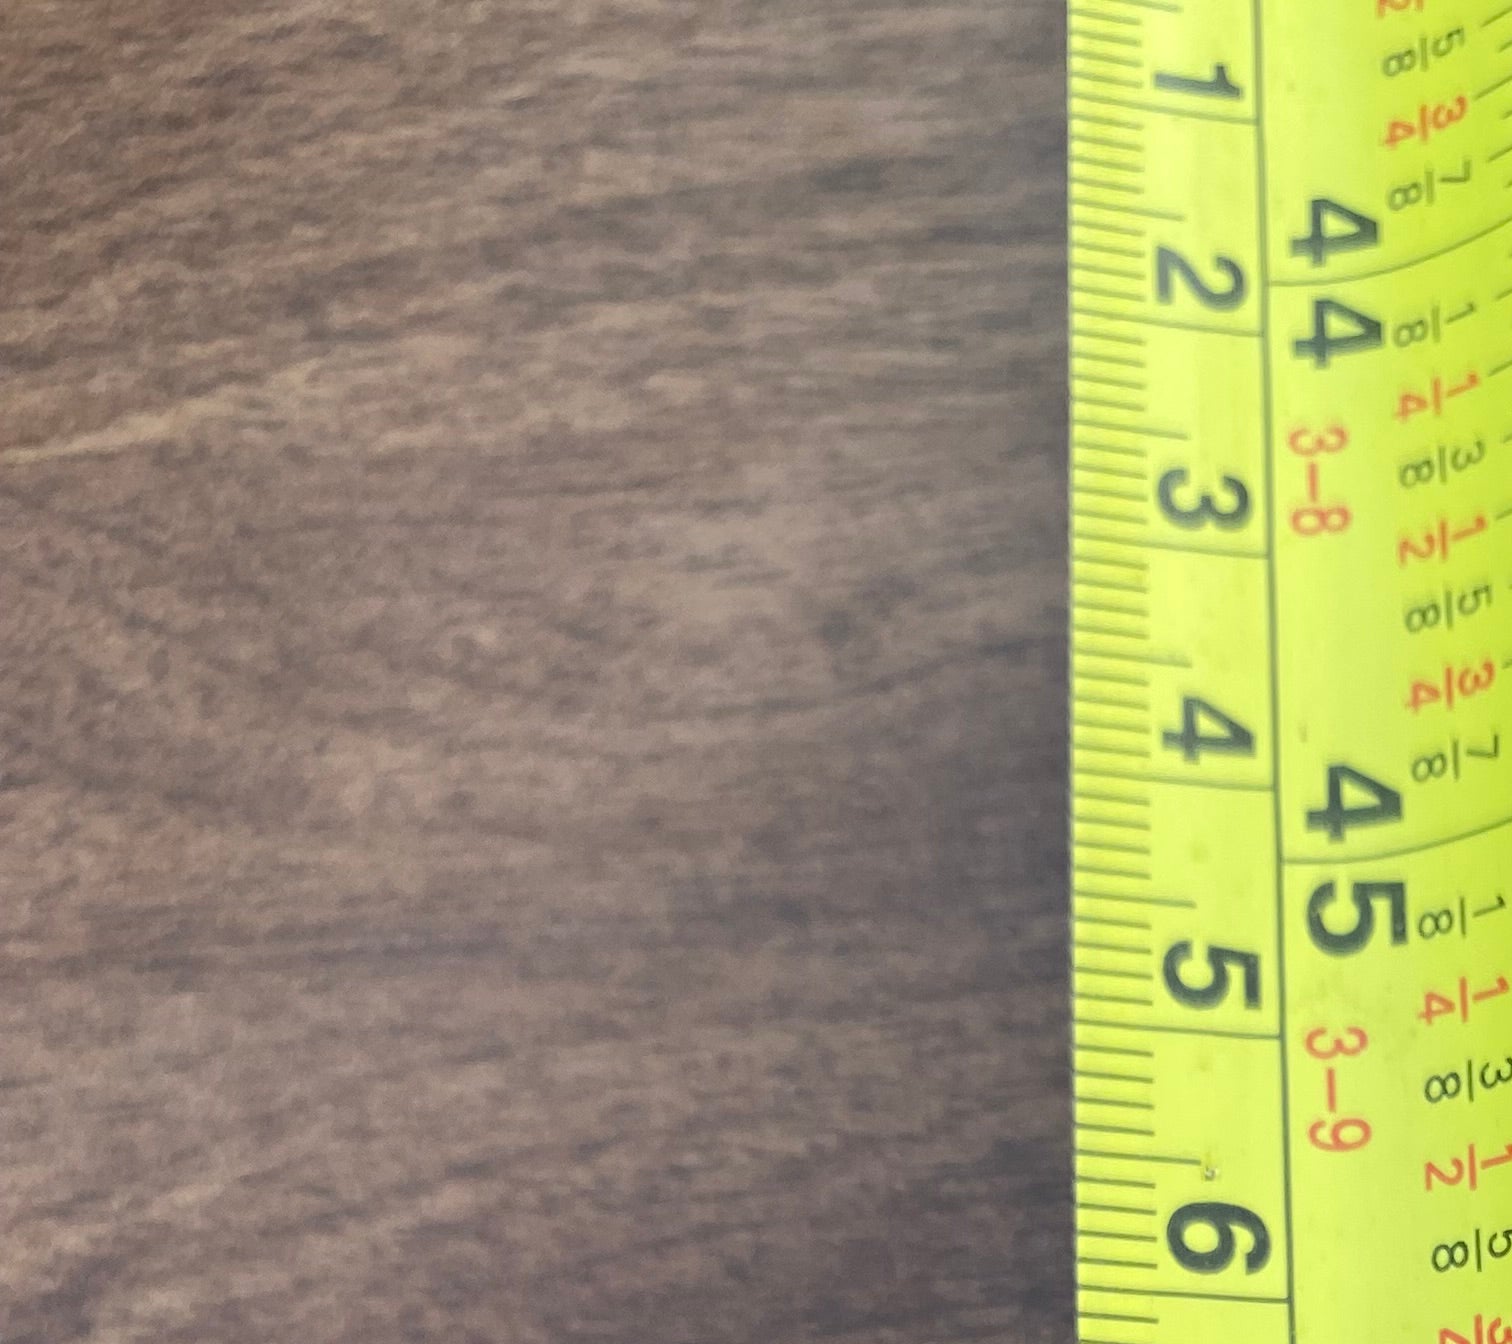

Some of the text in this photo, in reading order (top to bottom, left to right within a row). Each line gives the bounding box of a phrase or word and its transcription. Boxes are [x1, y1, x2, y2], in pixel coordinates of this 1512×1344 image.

[1154, 62, 1243, 100] 1
[1155, 244, 1248, 312] 2
[1156, 467, 1253, 531] 3
[1289, 426, 1351, 535] 3-8
[1162, 695, 1256, 764] 4
[1161, 940, 1262, 1010] 5
[1304, 1027, 1372, 1152] 3-9
[1166, 1201, 1272, 1275] 6
